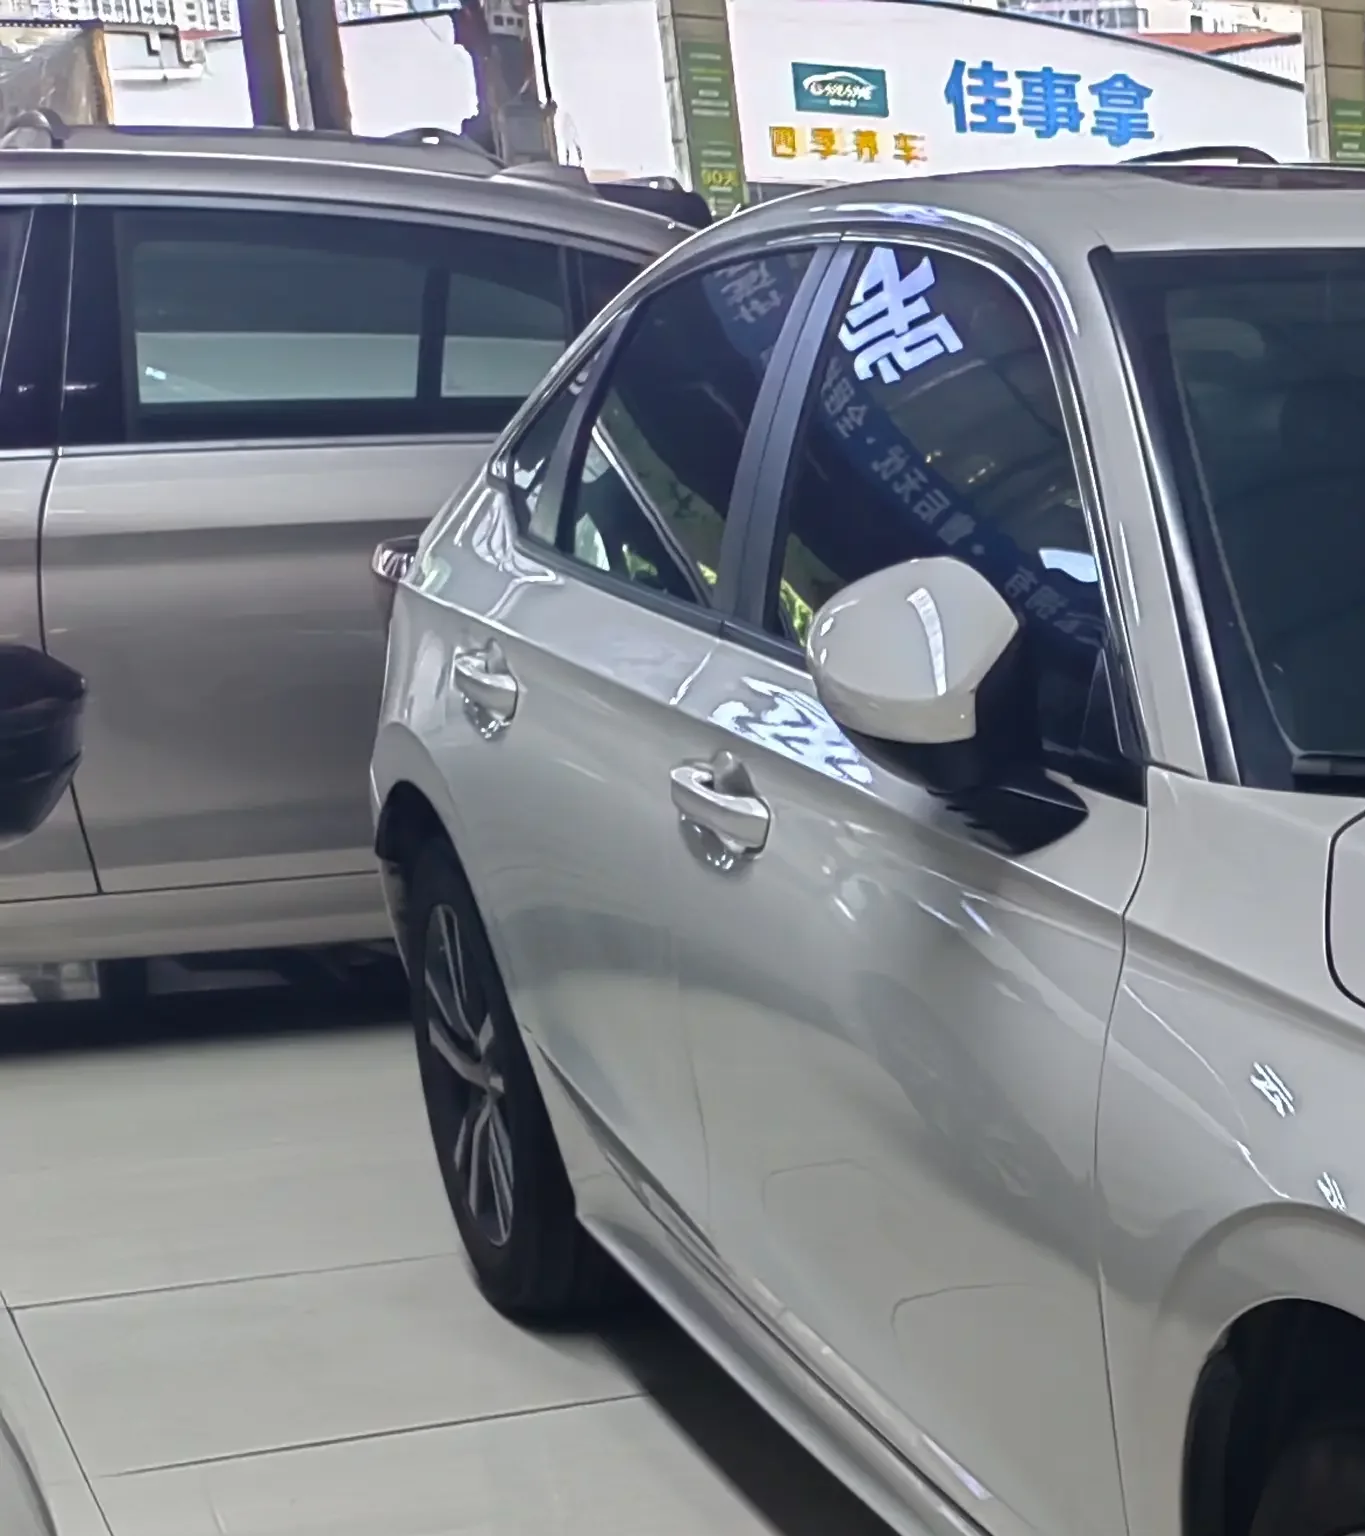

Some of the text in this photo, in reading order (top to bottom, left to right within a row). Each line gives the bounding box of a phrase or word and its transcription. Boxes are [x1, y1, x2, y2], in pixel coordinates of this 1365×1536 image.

[943, 58, 1156, 147] 佳事拿
[769, 126, 928, 165] 四季养车
